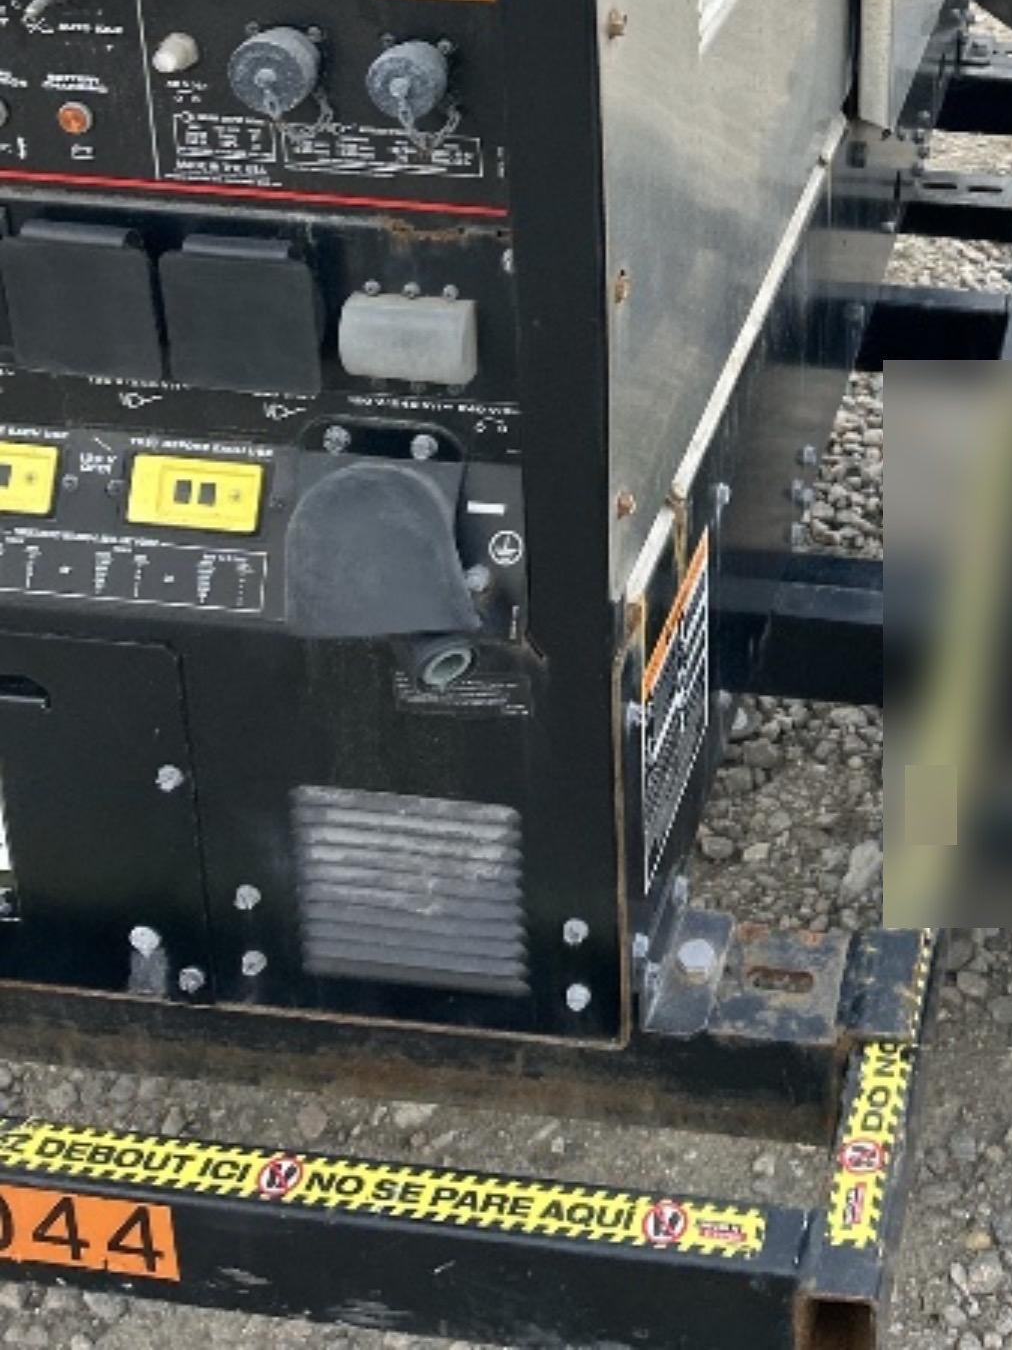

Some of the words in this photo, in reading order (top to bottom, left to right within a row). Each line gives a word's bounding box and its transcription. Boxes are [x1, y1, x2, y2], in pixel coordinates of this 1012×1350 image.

[861, 1085, 890, 1130] DO
[35, 1136, 193, 1175] DEBOUT
[200, 1159, 253, 1183] ICI
[305, 1172, 366, 1195] NO
[371, 1180, 426, 1203] SE
[430, 1186, 534, 1217] PARE
